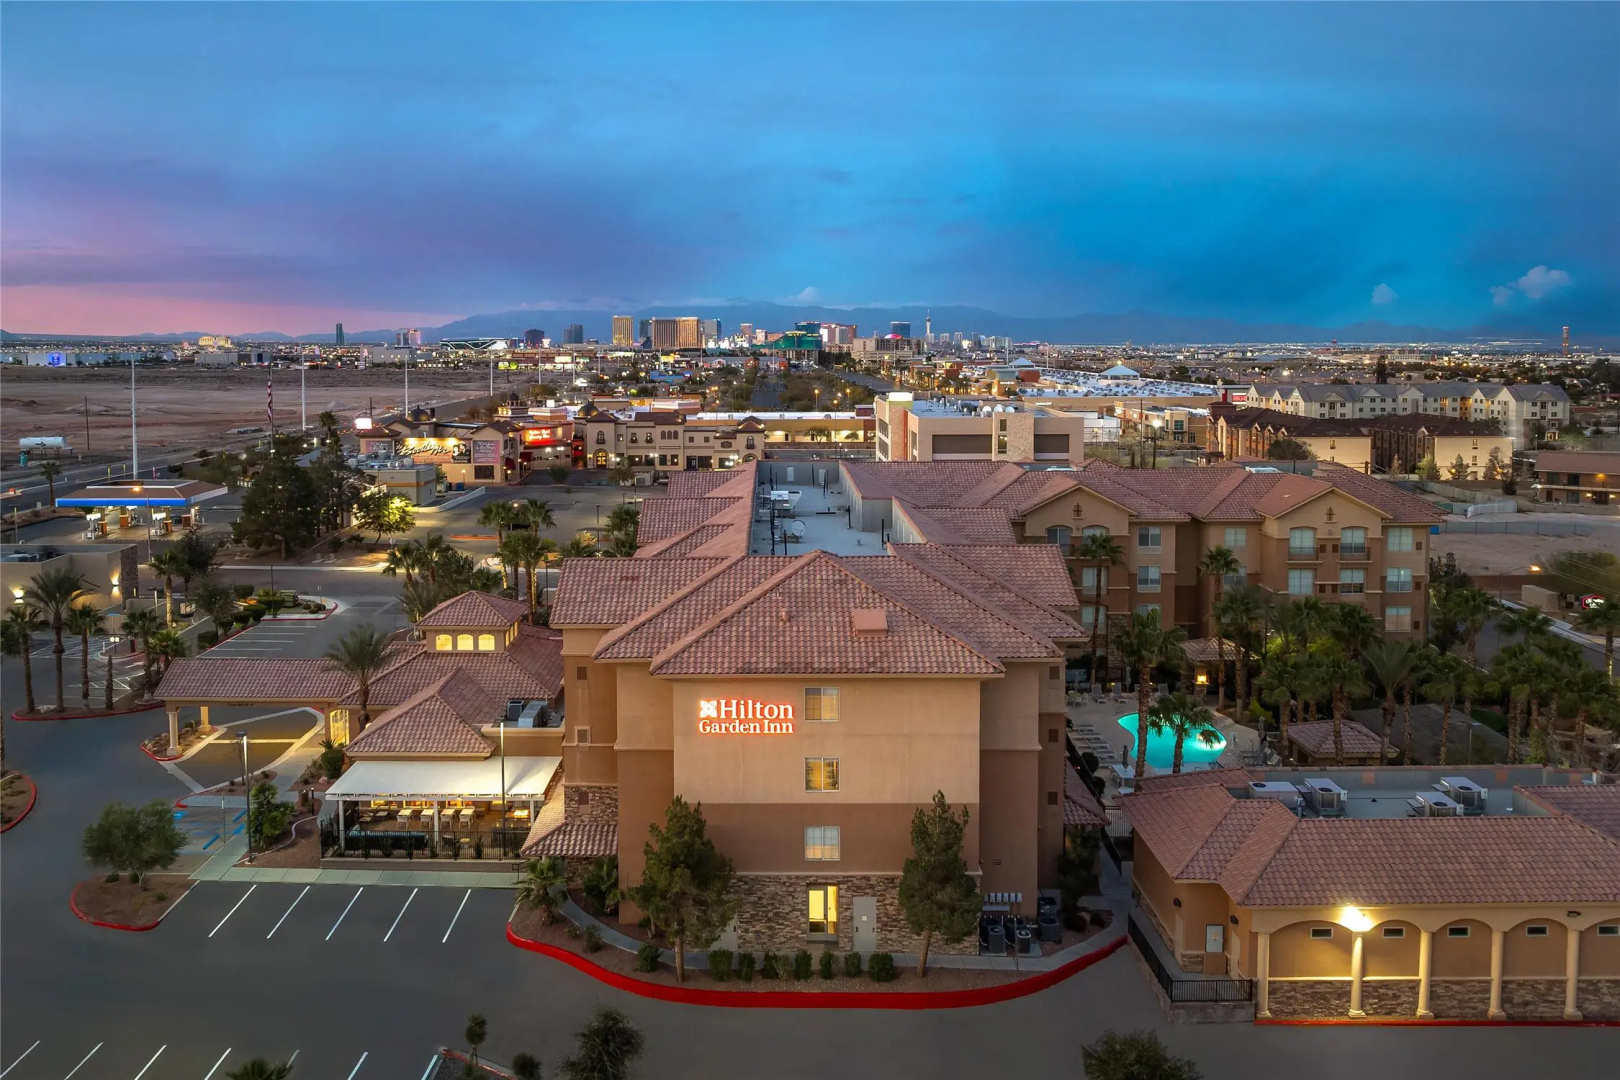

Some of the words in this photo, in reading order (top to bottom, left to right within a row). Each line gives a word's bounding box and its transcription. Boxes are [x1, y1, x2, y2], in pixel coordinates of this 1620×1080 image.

[719, 699, 794, 719] Hilton
[698, 719, 761, 734] Garden
[763, 719, 794, 734] Inn
